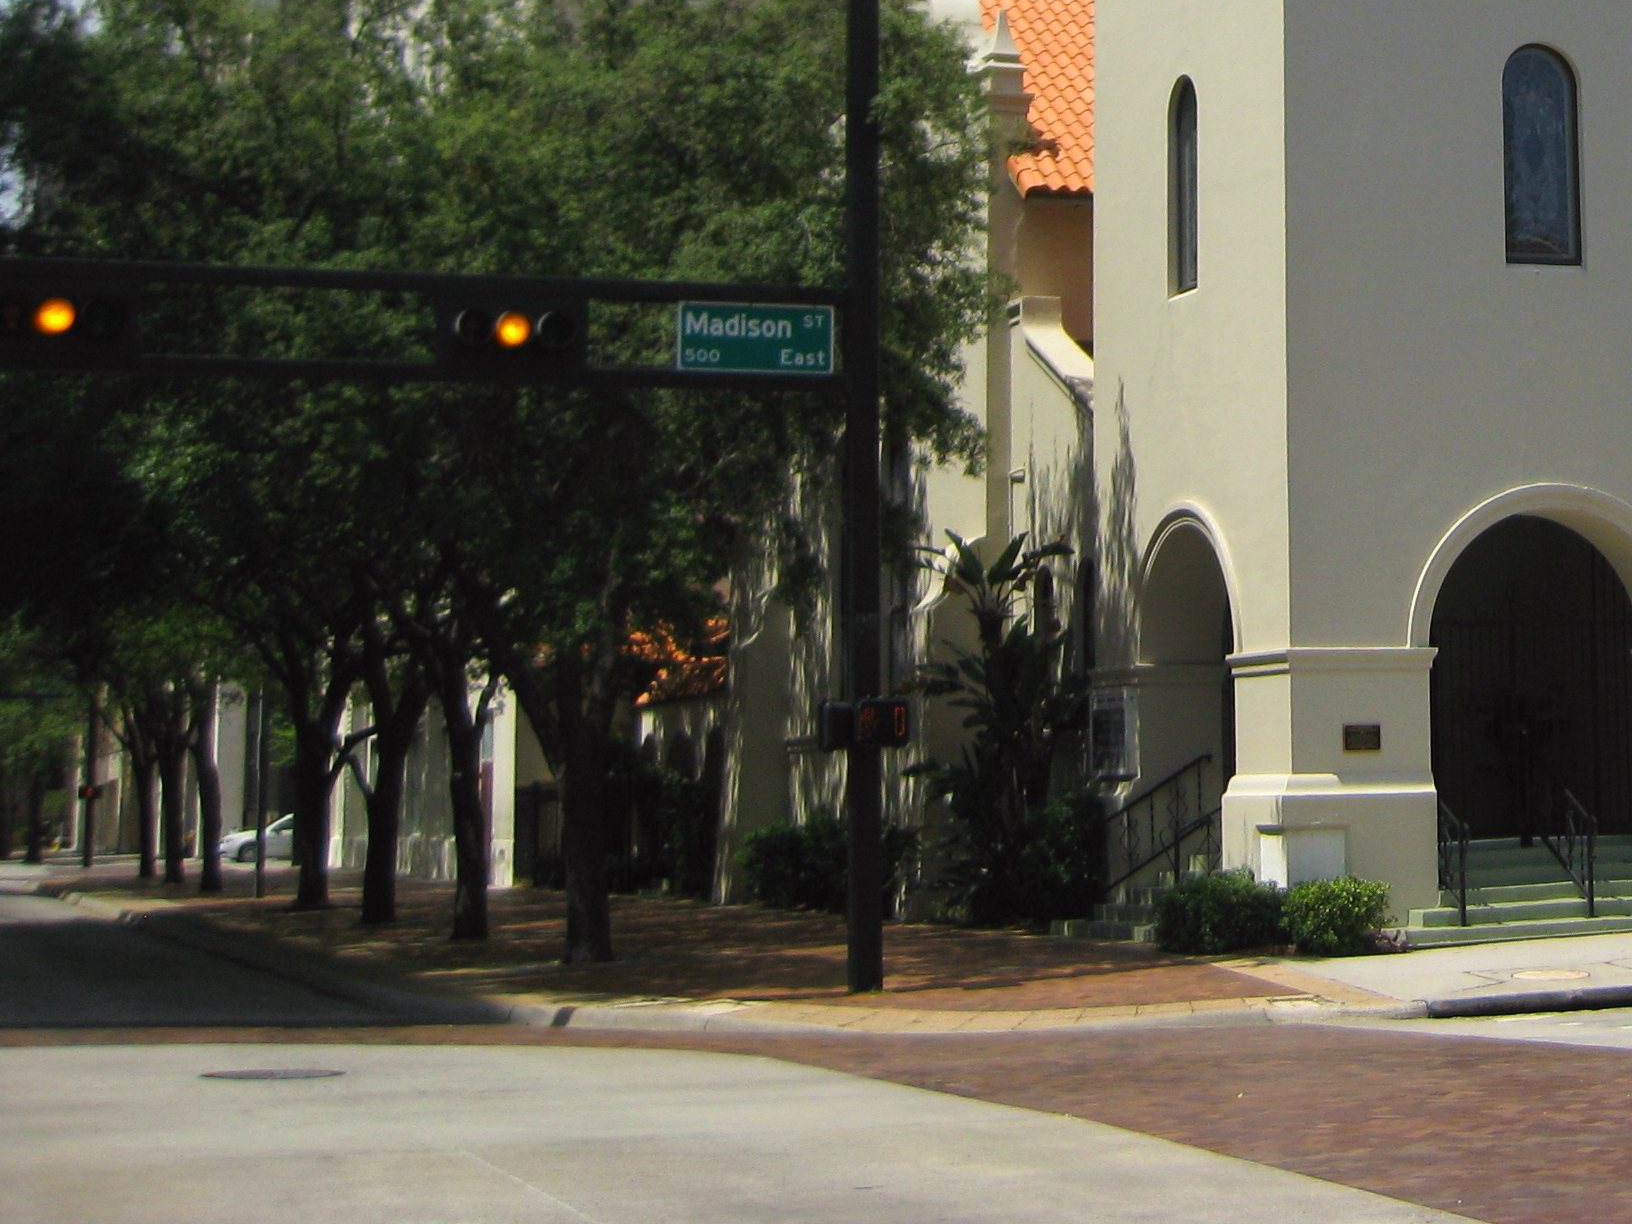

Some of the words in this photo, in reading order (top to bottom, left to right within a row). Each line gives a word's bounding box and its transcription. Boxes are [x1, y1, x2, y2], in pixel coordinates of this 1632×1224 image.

[685, 311, 792, 339] Madison
[802, 314, 825, 329] ST
[684, 348, 720, 363] 500
[780, 349, 826, 366] East
